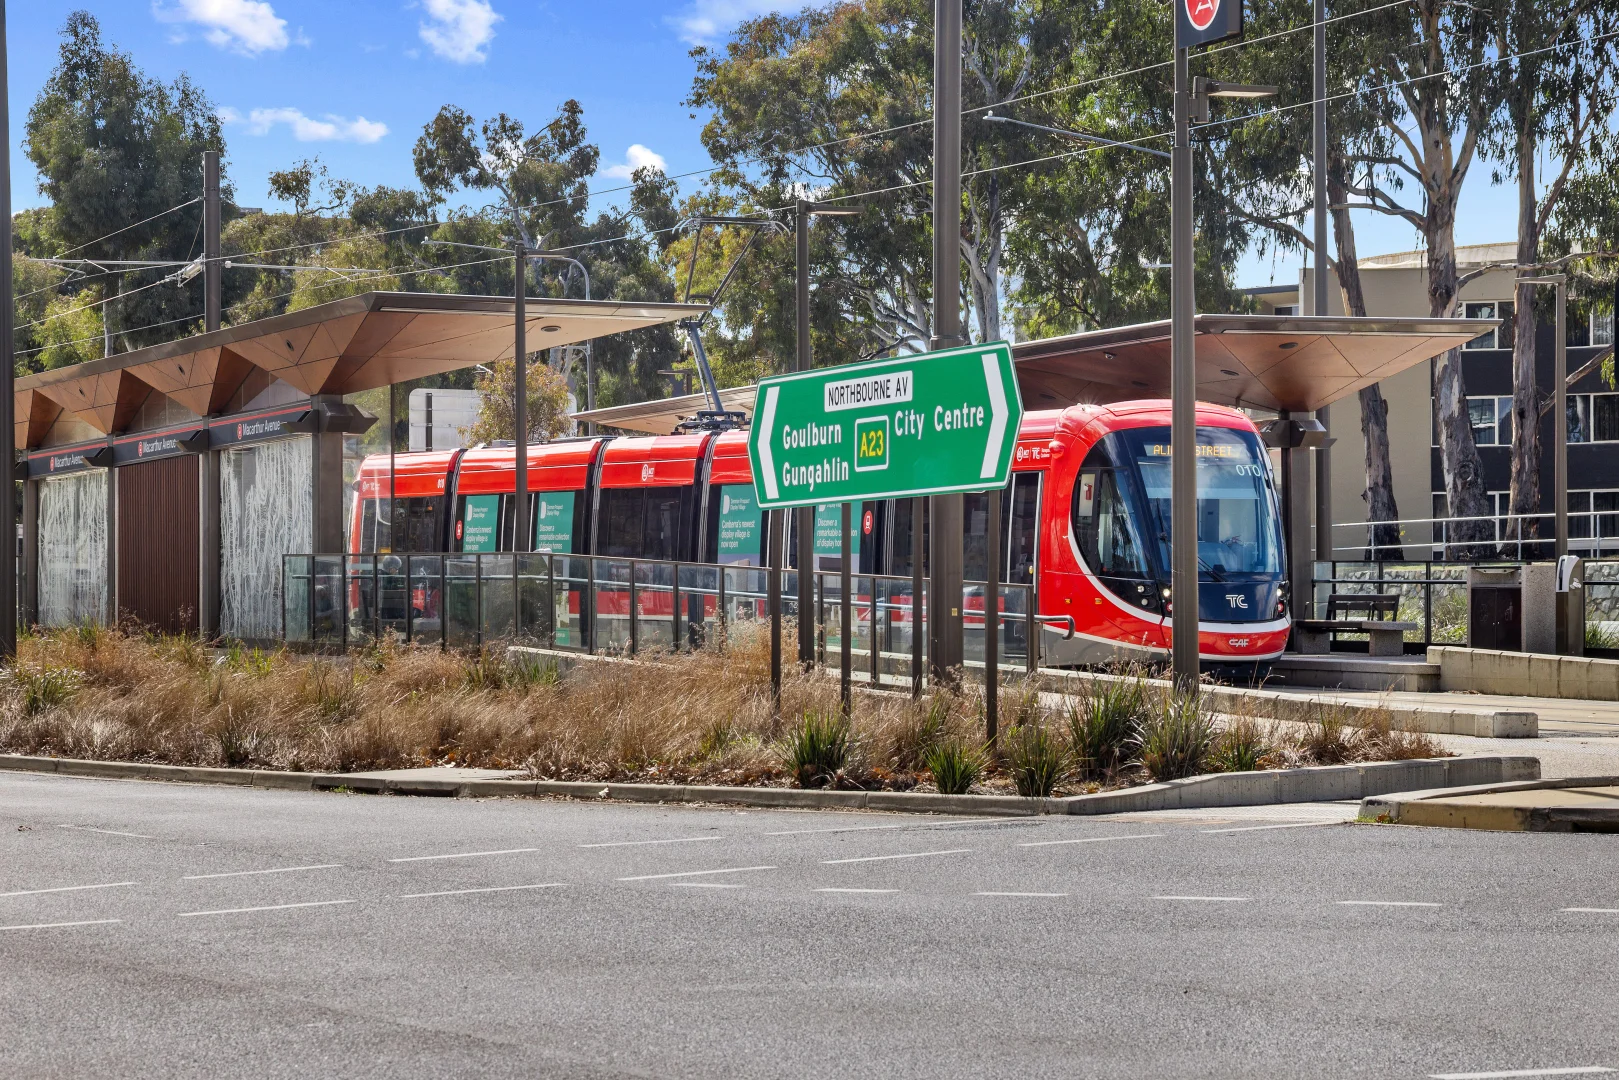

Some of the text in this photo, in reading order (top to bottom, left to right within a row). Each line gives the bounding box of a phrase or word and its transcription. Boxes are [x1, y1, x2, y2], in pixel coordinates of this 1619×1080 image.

[828, 377, 909, 406] NORTHBOURNE AV
[894, 402, 985, 440] City Centre
[242, 420, 281, 436] Macarthur Avenue
[782, 422, 842, 450] Goulburn
[142, 439, 163, 453] Macarthur
[859, 430, 884, 458] A23
[1195, 445, 1233, 457] STREET
[54, 455, 71, 468] Macarthur
[782, 457, 849, 492] Gungahlin
[722, 520, 755, 528] Canberra's newest
[818, 518, 834, 526] Discover
[722, 530, 735, 540] display
[735, 530, 747, 540] village
[817, 528, 838, 537] remarkable
[730, 541, 739, 550] open
[1225, 594, 1249, 609] TC
[1228, 638, 1250, 648] CAF
